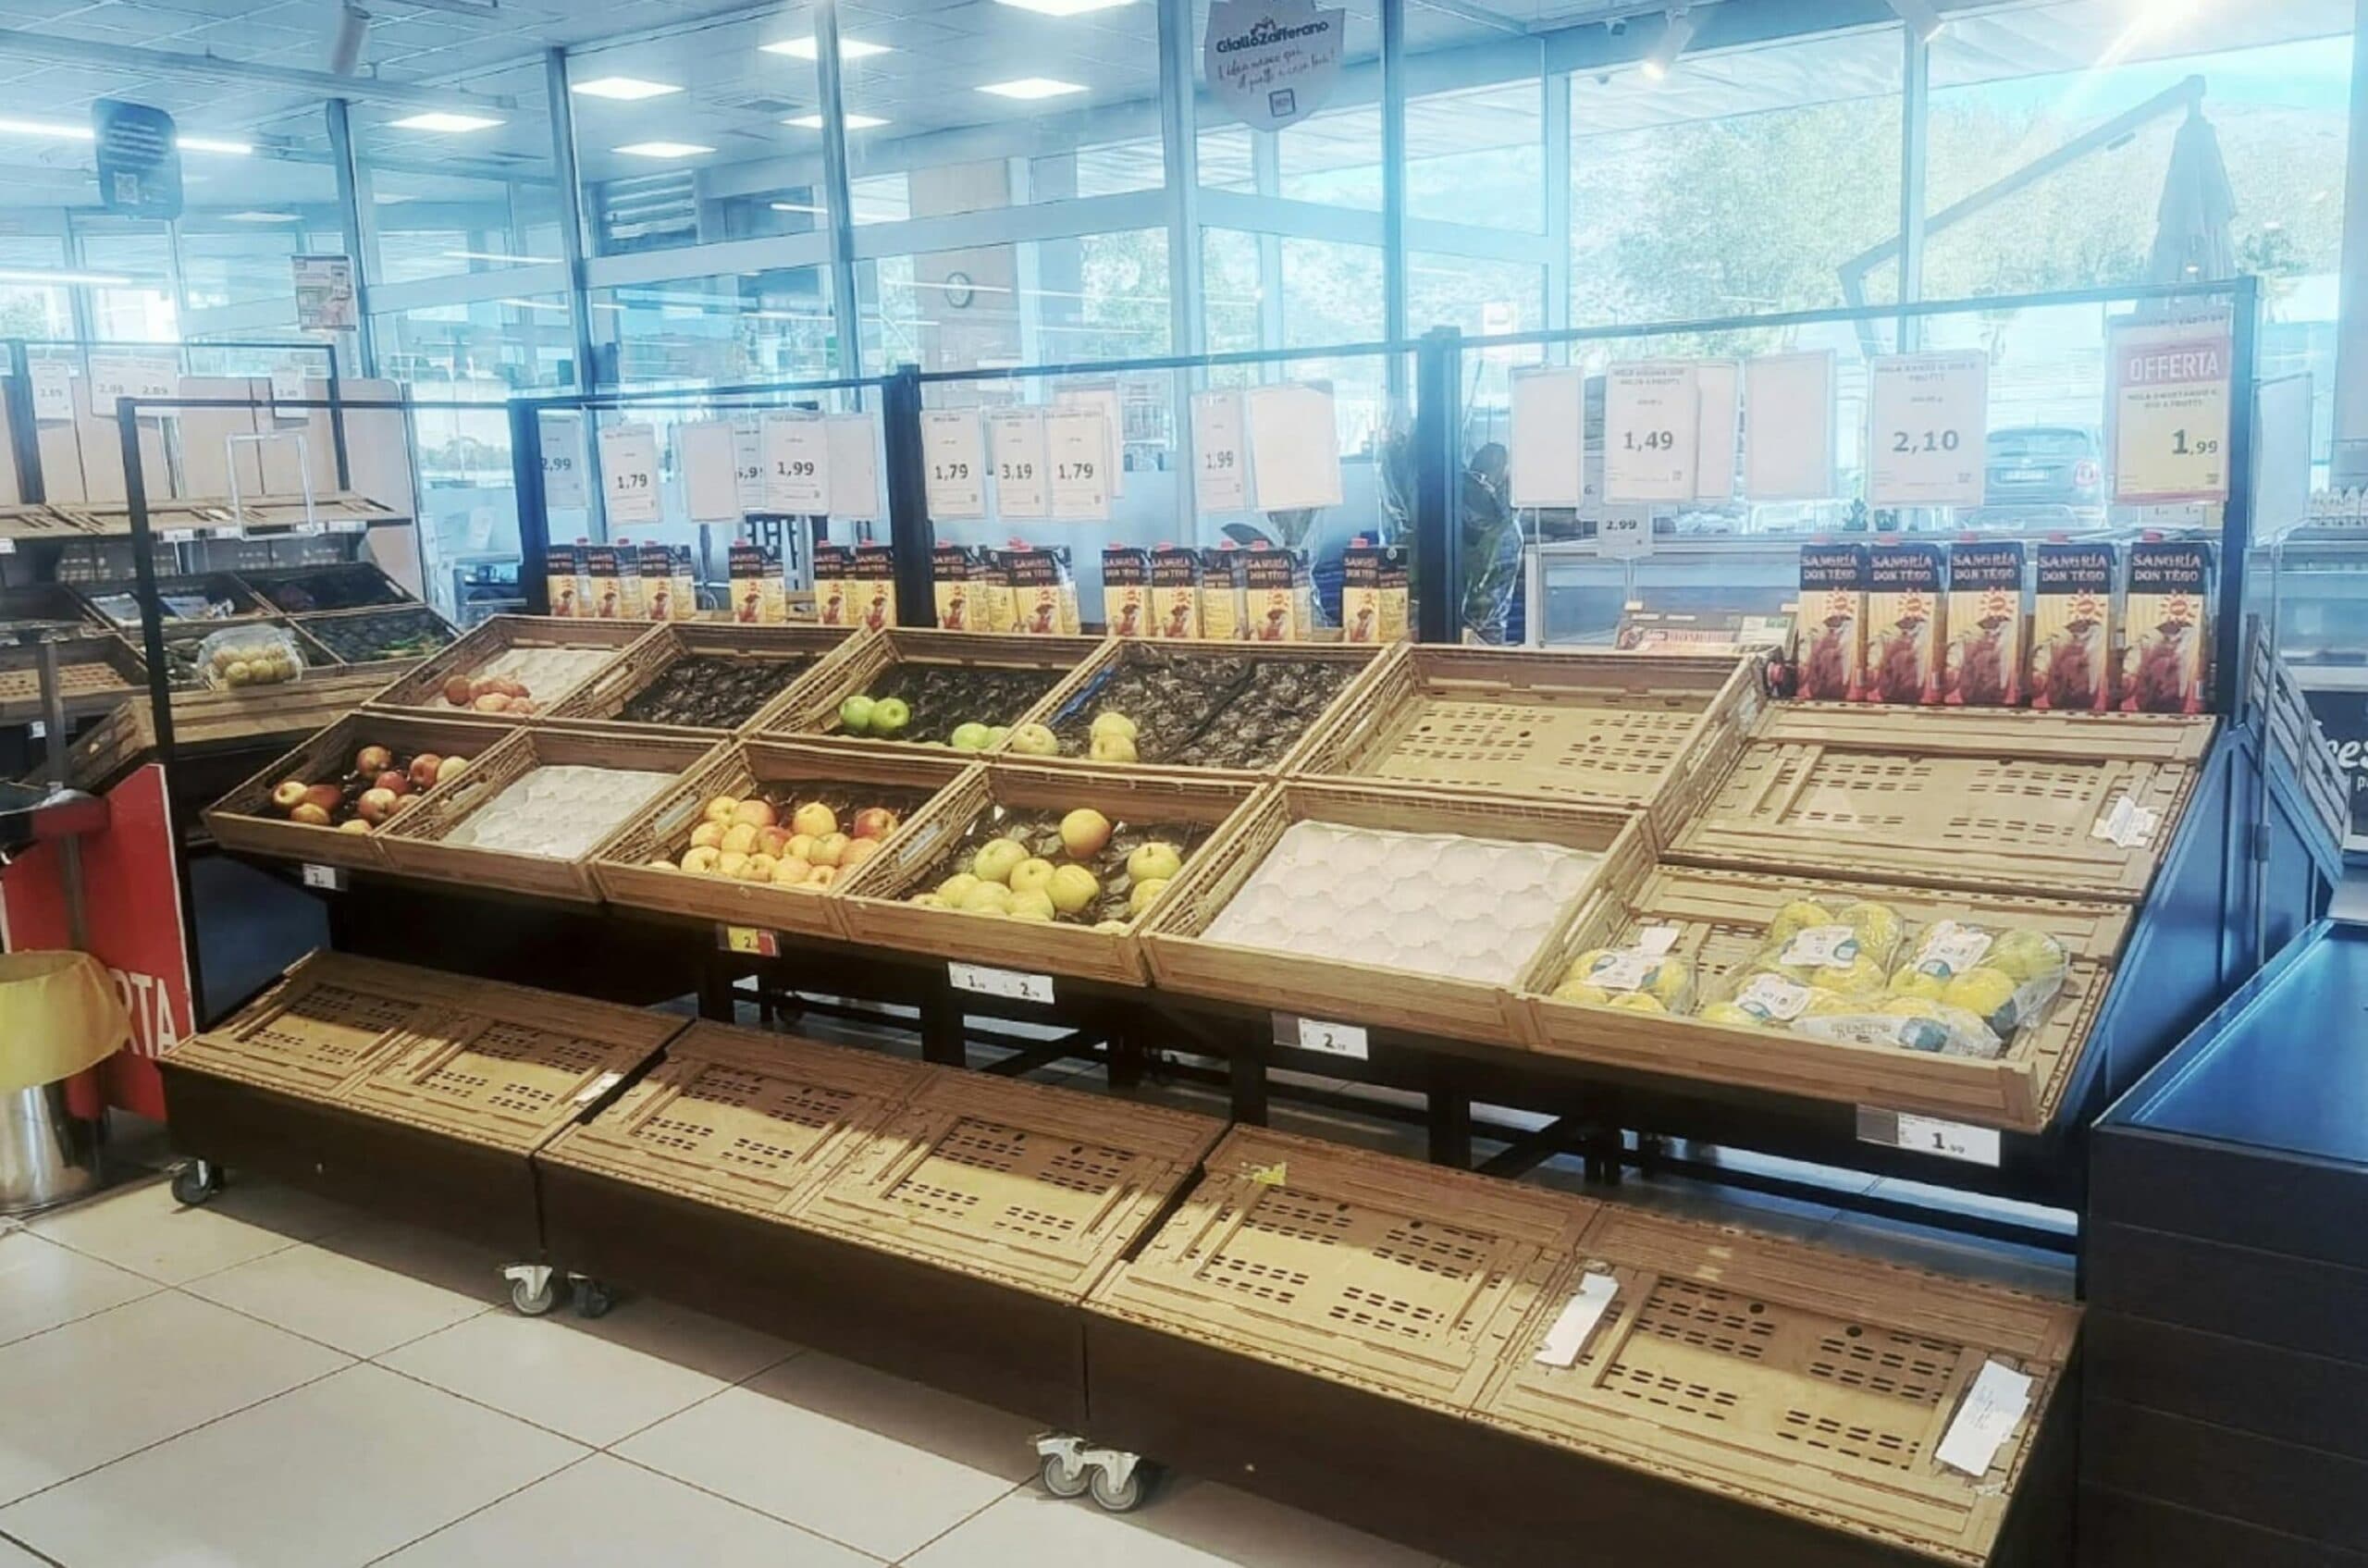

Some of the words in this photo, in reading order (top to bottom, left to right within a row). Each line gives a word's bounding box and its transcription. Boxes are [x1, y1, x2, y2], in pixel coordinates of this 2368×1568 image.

[2130, 351, 2219, 381] OFFERTA
[1623, 430, 1673, 452] 1,49
[1893, 429, 1959, 454] 2,10
[2173, 428, 2218, 455] 1,99
[777, 462, 815, 476] 1,99
[1205, 450, 1234, 471] 1,99
[935, 463, 968, 481] 1,79
[1002, 463, 1032, 480] 3,19
[1058, 463, 1093, 480] 1,79
[618, 475, 648, 489] 1,79
